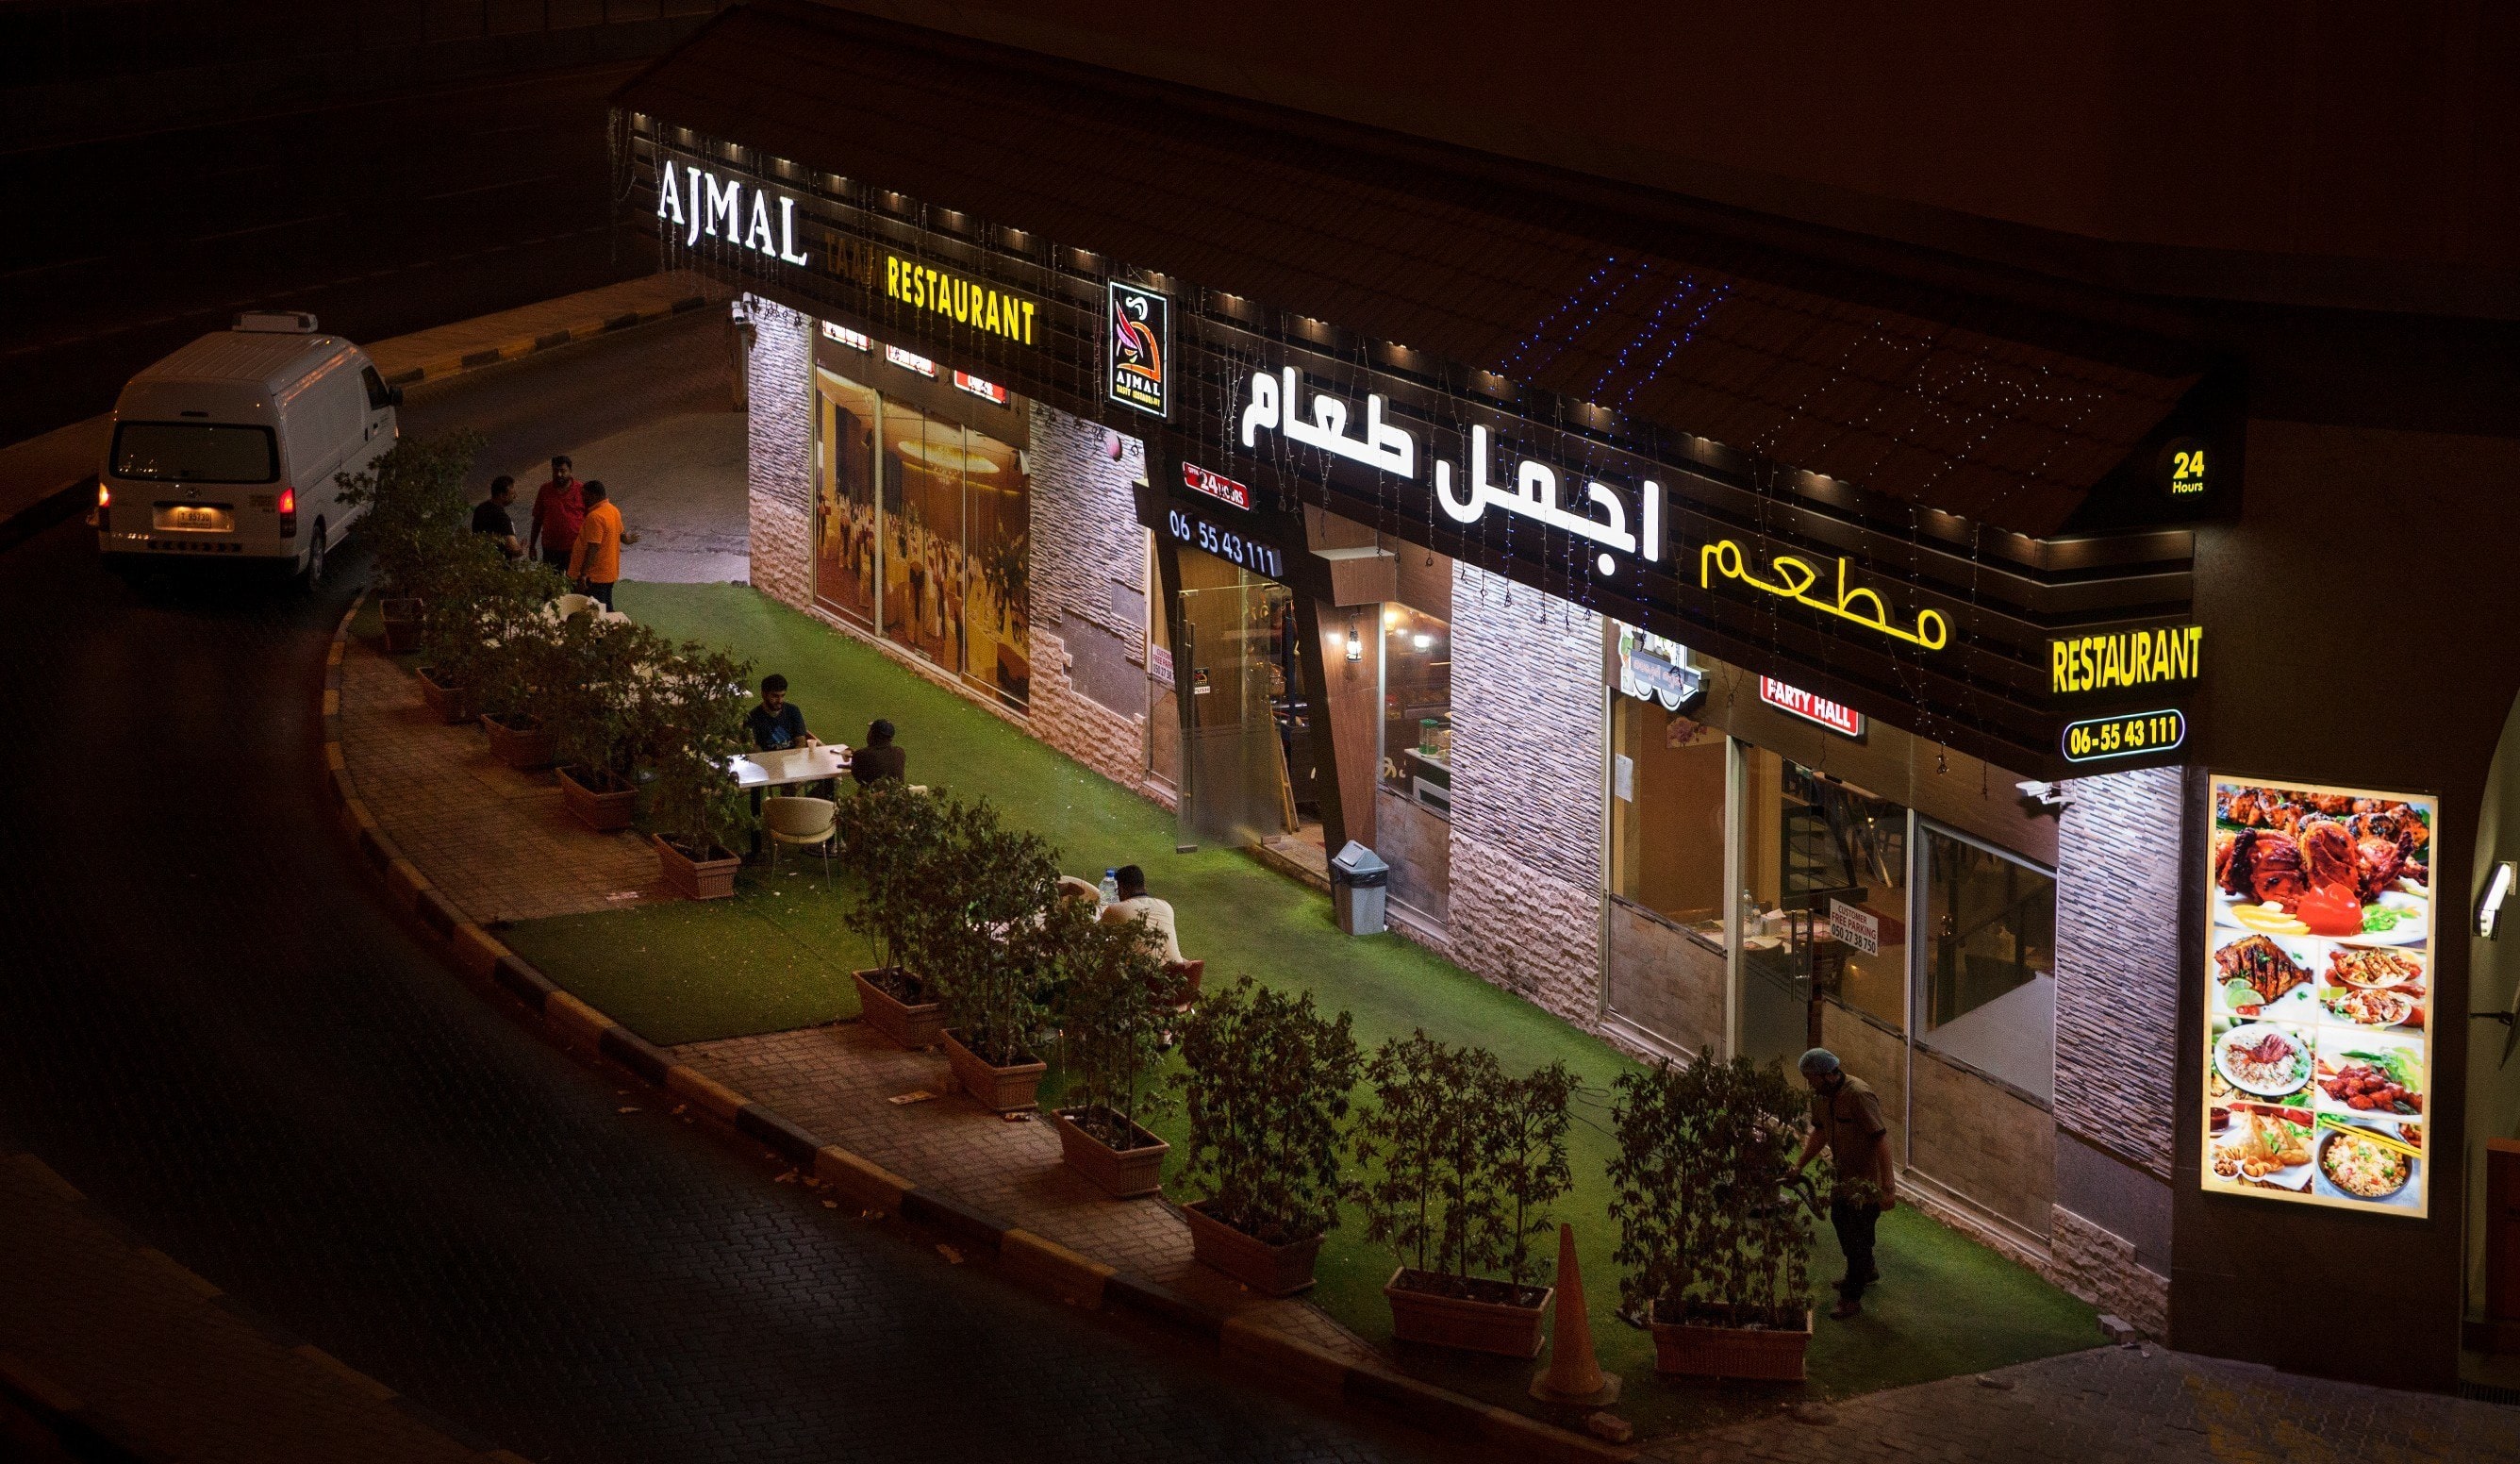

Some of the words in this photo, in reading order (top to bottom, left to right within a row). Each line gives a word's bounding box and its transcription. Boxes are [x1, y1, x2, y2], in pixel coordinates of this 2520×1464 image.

[657, 159, 808, 266] AJMAL
[887, 255, 1035, 345] RESTAURANT
[1117, 370, 1161, 396] AJMAL
[1241, 366, 1414, 479] طعام
[2172, 450, 2205, 480] 24
[1199, 470, 1219, 494] 24
[2172, 481, 2204, 493] Hours
[1435, 424, 1660, 576] اجمل
[1169, 509, 1190, 541] 06
[1199, 521, 1219, 554] 55
[1222, 532, 1243, 564] 43
[1247, 541, 1275, 577] 111
[1700, 540, 1947, 651] مطعم
[2052, 625, 2203, 693] RESTAURANT
[1814, 695, 1851, 728] HALL
[2070, 723, 2121, 756] 06-55
[2124, 719, 2145, 747] 43
[2149, 715, 2177, 743] 111
[1832, 911, 1848, 927] FREE
[1849, 919, 1877, 940] PARKING
[1838, 906, 1867, 925] CUSTOMER
[1832, 923, 1844, 940] 050
[1845, 929, 1853, 943] 27
[1854, 933, 1863, 948] 38
[1864, 938, 1876, 954] 750
